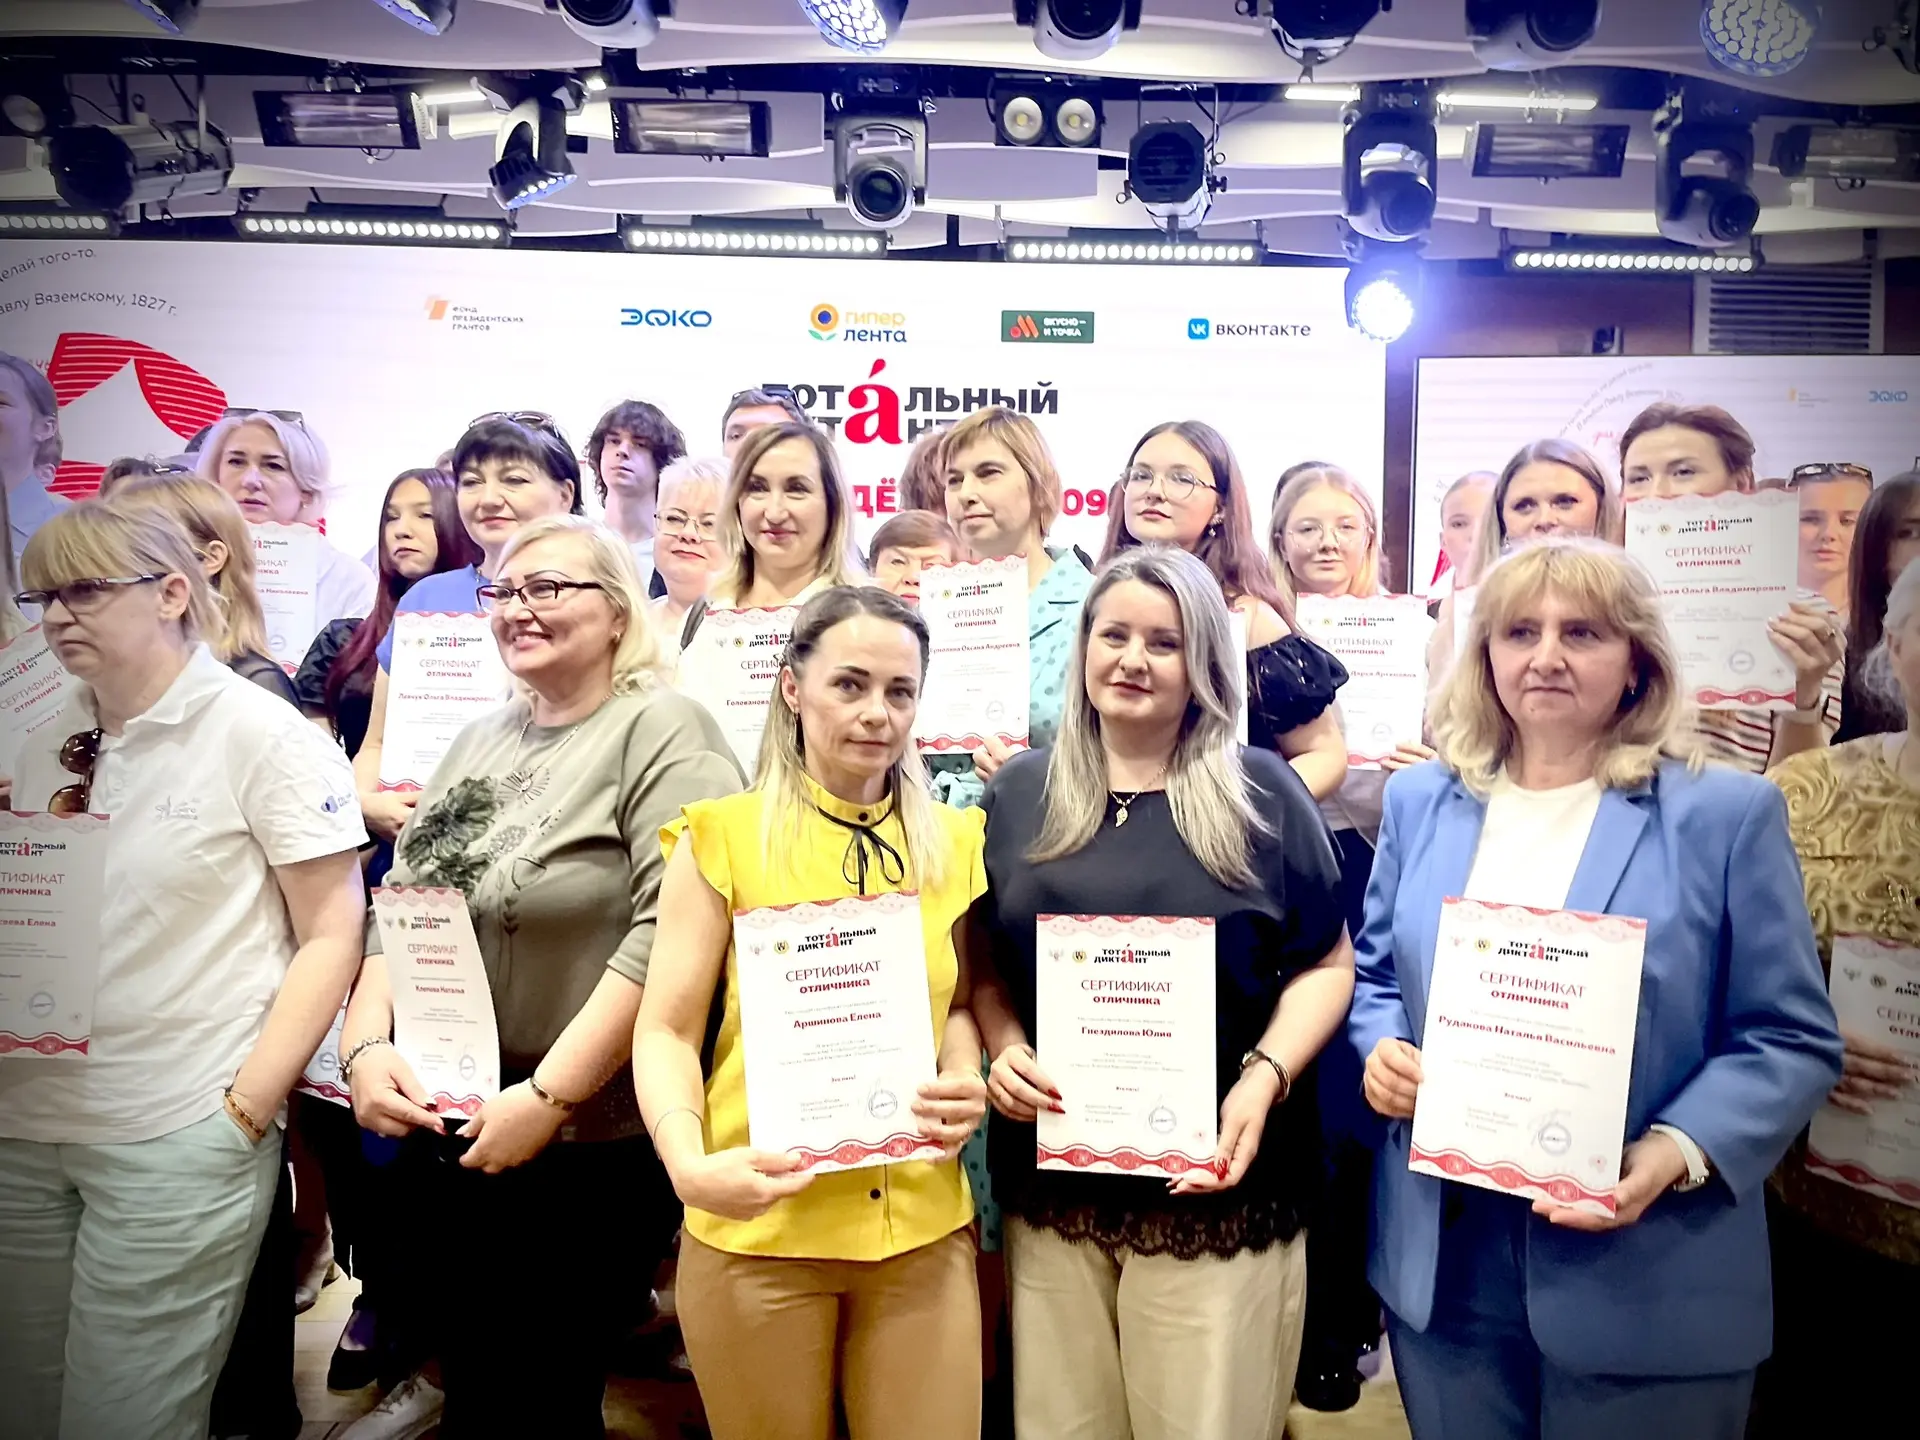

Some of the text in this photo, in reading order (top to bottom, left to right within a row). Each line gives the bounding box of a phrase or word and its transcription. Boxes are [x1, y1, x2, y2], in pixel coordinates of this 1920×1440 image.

[34, 292, 126, 306] Вяземскому,
[132, 294, 166, 311] 1827
[1665, 544, 1753, 558] СЕРТИФИКАТ
[1676, 559, 1741, 568] отличника
[947, 606, 1004, 620] СЕРТИФИКАТ
[419, 659, 483, 668] СЕРТИФИКАТ
[27, 918, 56, 927] Елена
[785, 960, 881, 982] СЕРТИФИКАТ
[799, 979, 870, 994] отличника
[1081, 979, 1172, 993] СЕРТИФИКАТ
[1480, 970, 1586, 998] СЕРТИФИКАТ
[1093, 996, 1161, 1006] отличника
[1491, 990, 1569, 1009] отличника
[793, 1012, 882, 1030] Аршинова Елена
[1081, 1025, 1172, 1038] Гнездилова Юлия
[1438, 1015, 1492, 1032] Рудакова
[1494, 1025, 1543, 1042] Наталья
